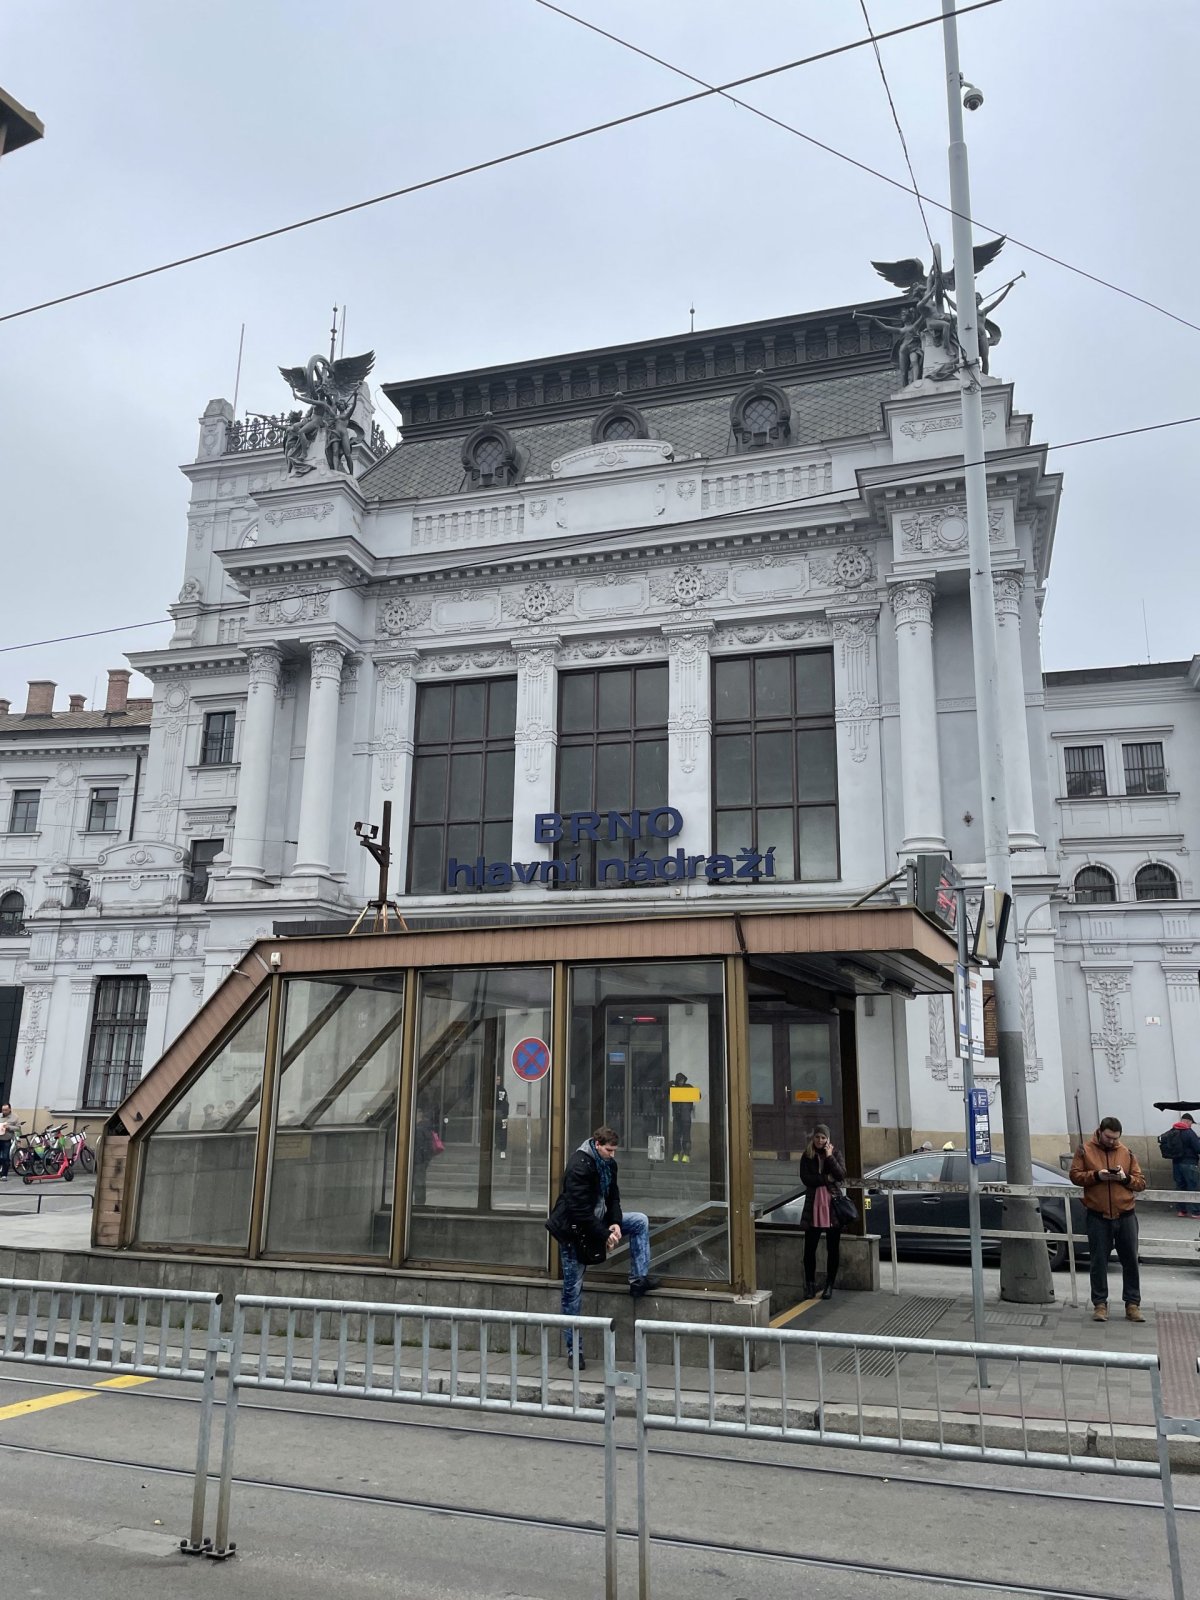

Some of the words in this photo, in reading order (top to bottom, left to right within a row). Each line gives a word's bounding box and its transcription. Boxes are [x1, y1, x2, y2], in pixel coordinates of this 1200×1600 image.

[534, 806, 683, 844] BRNO
[448, 853, 582, 888] hlavní
[600, 846, 777, 882] nádraží
